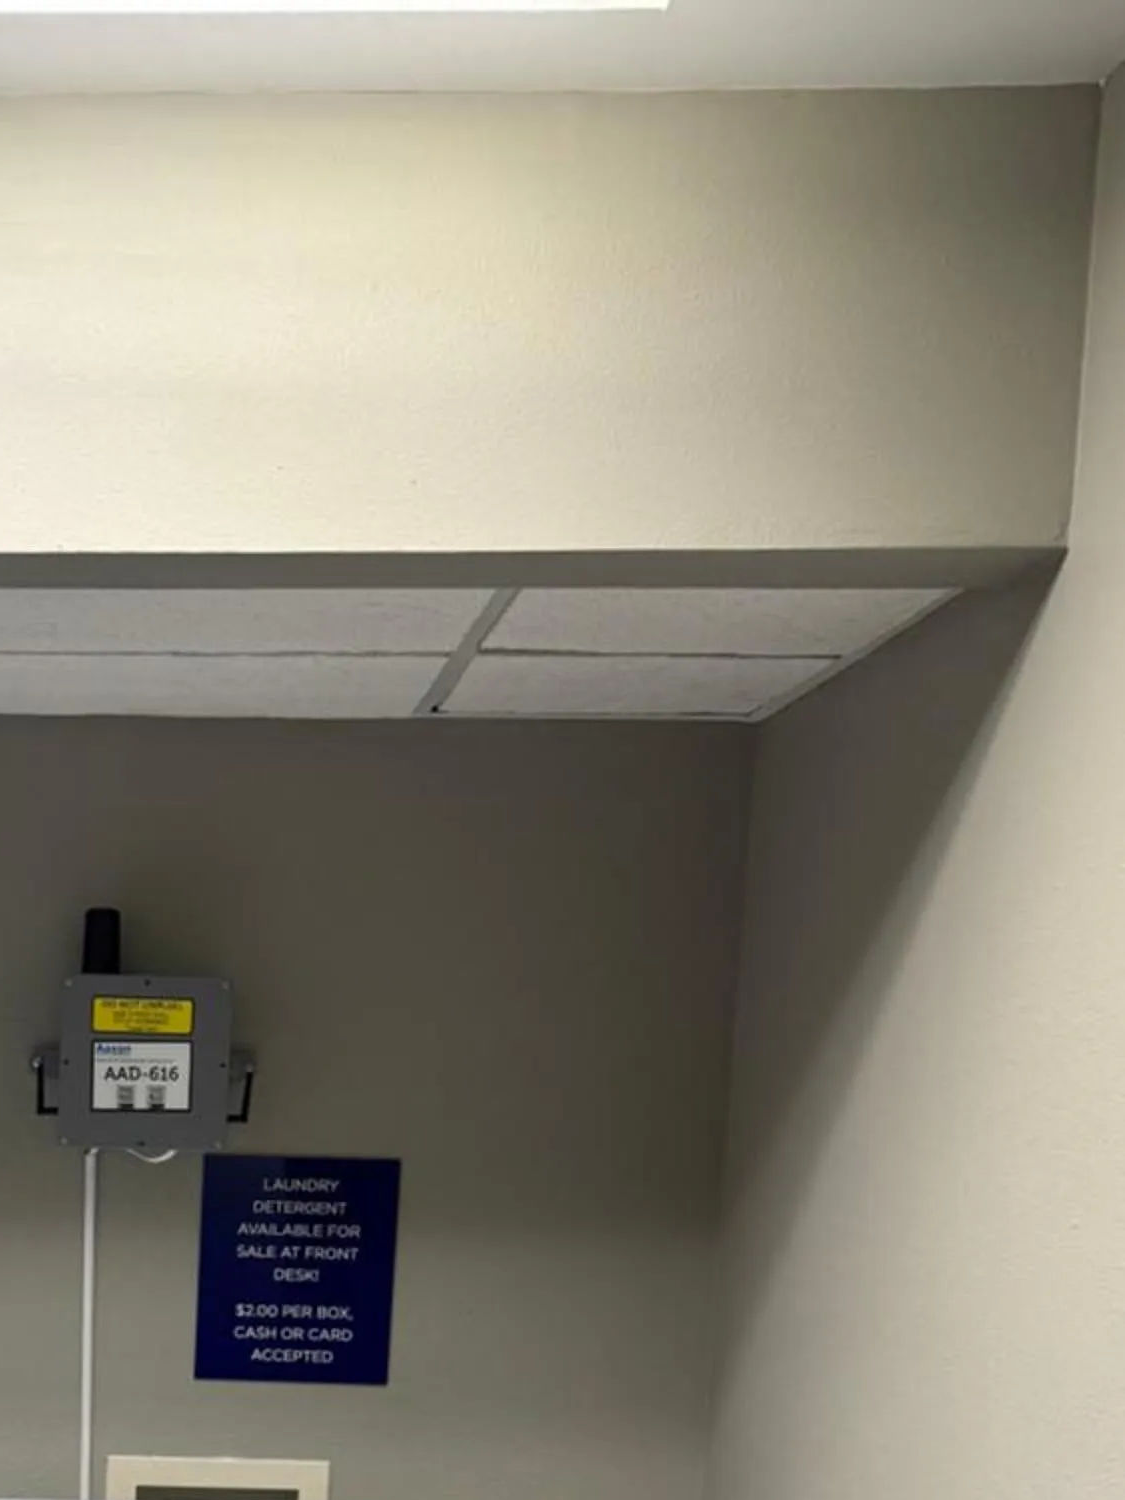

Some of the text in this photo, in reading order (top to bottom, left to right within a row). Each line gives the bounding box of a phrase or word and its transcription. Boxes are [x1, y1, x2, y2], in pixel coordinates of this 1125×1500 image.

[104, 1066, 179, 1081] AAD-616
[263, 1178, 339, 1192] LAUNDRY
[253, 1201, 347, 1215] DETERGENT
[238, 1223, 361, 1238] AVAILABLE FOR
[237, 1245, 359, 1261] SALE AT FRONT
[235, 1303, 278, 1318] $2.00
[282, 1305, 312, 1319] PER
[234, 1326, 353, 1342] CASH OR CARD
[251, 1348, 333, 1364] ACCEPTED
